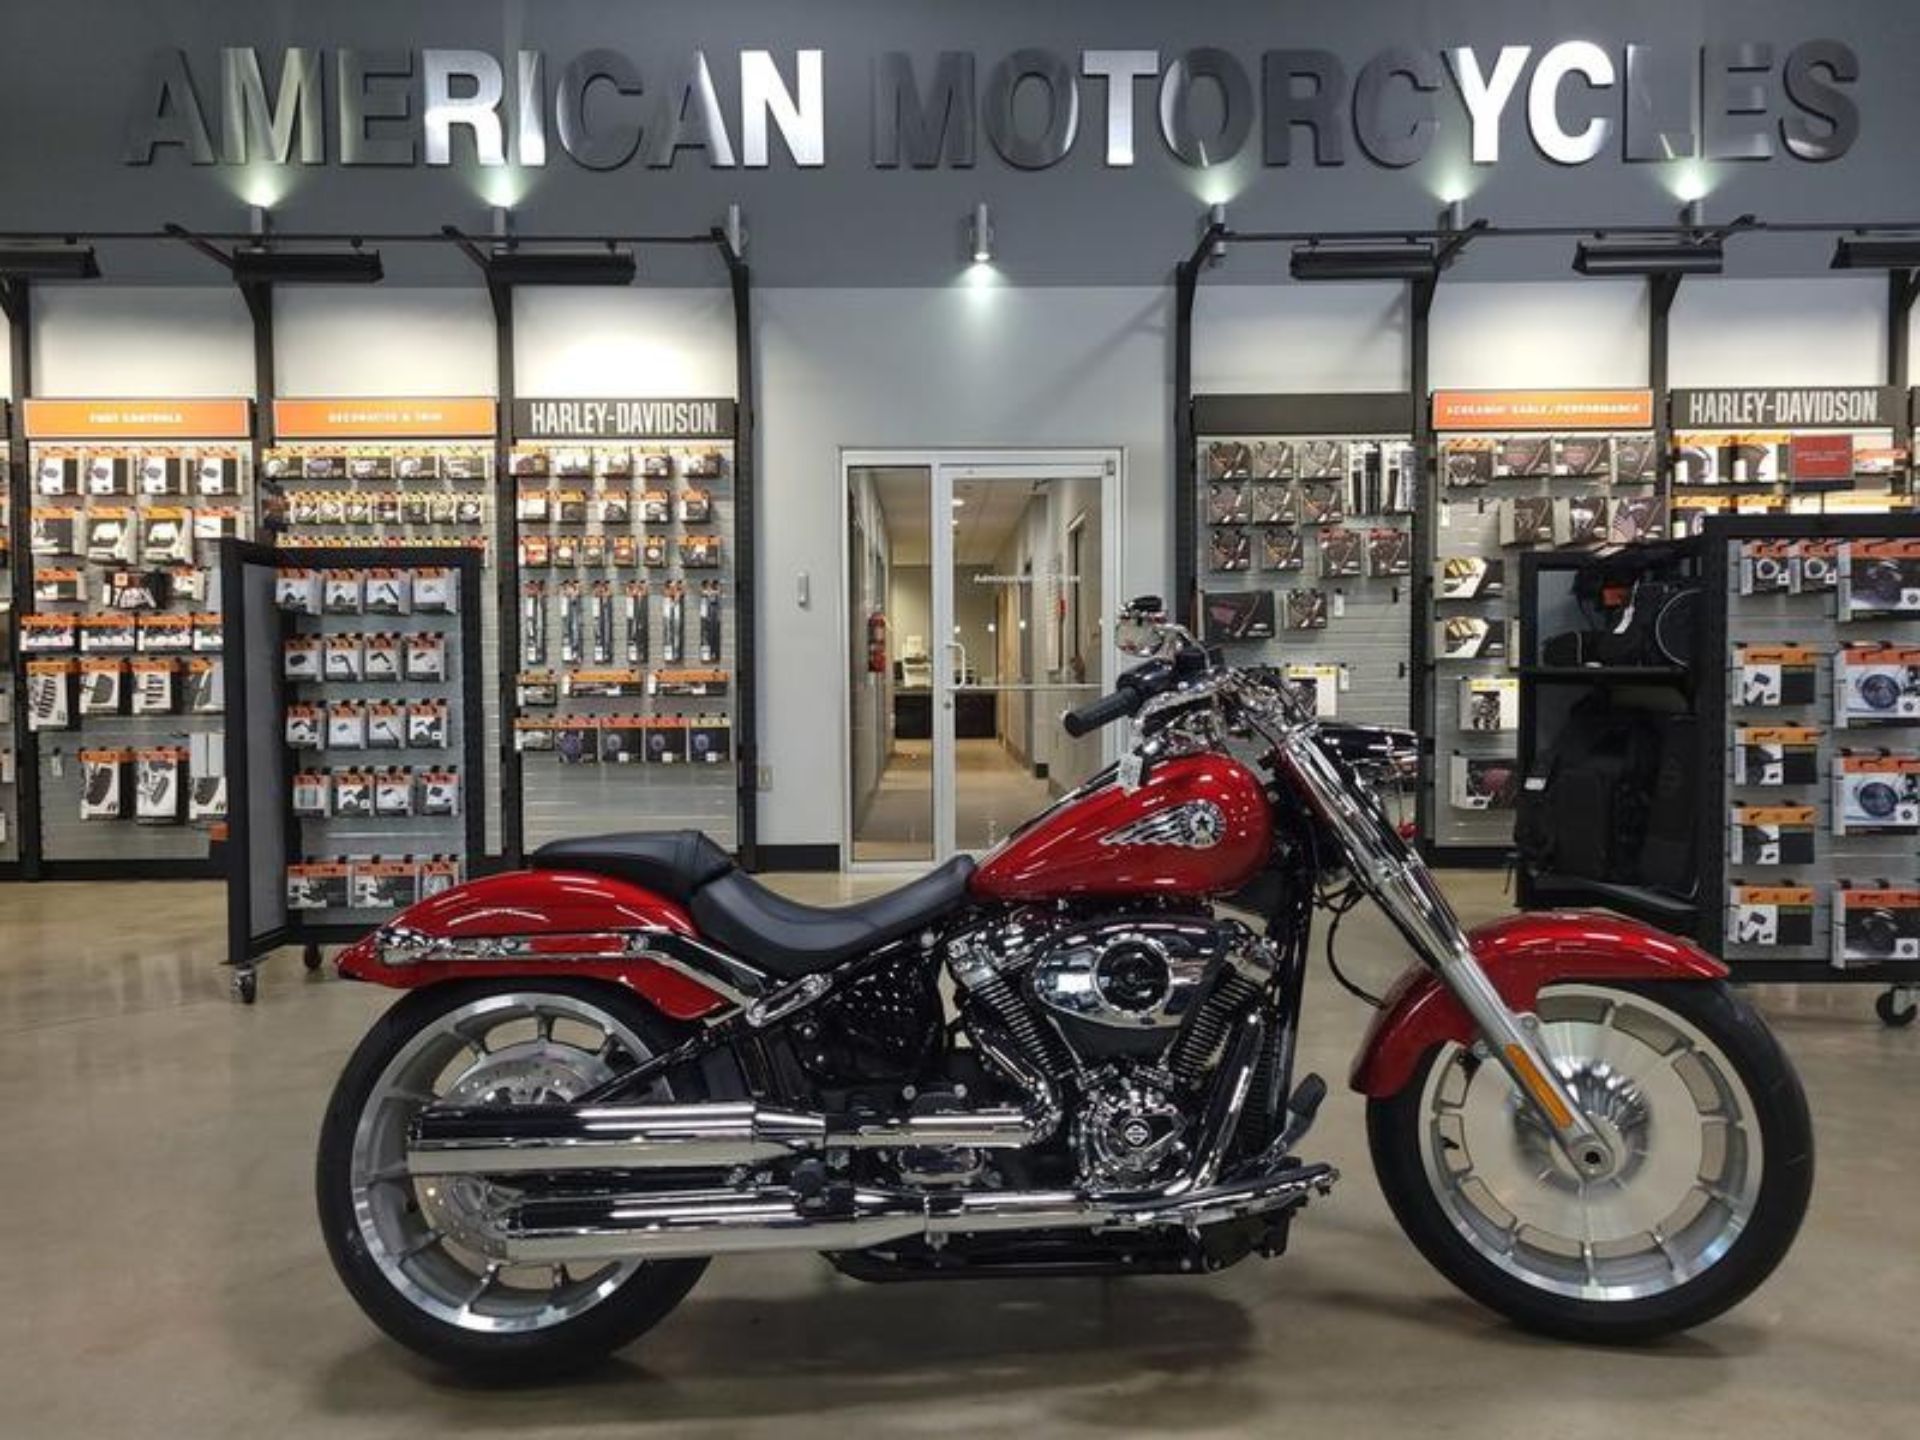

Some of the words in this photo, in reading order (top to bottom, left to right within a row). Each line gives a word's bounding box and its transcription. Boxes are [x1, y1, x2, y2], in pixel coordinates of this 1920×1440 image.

[126, 47, 824, 169] AMERICAN
[872, 39, 1860, 167] MOTORCYCLES
[530, 402, 717, 434] HARLEY-DAVIDSON
[1689, 390, 1878, 424] HARLEY-DAVIDSON
